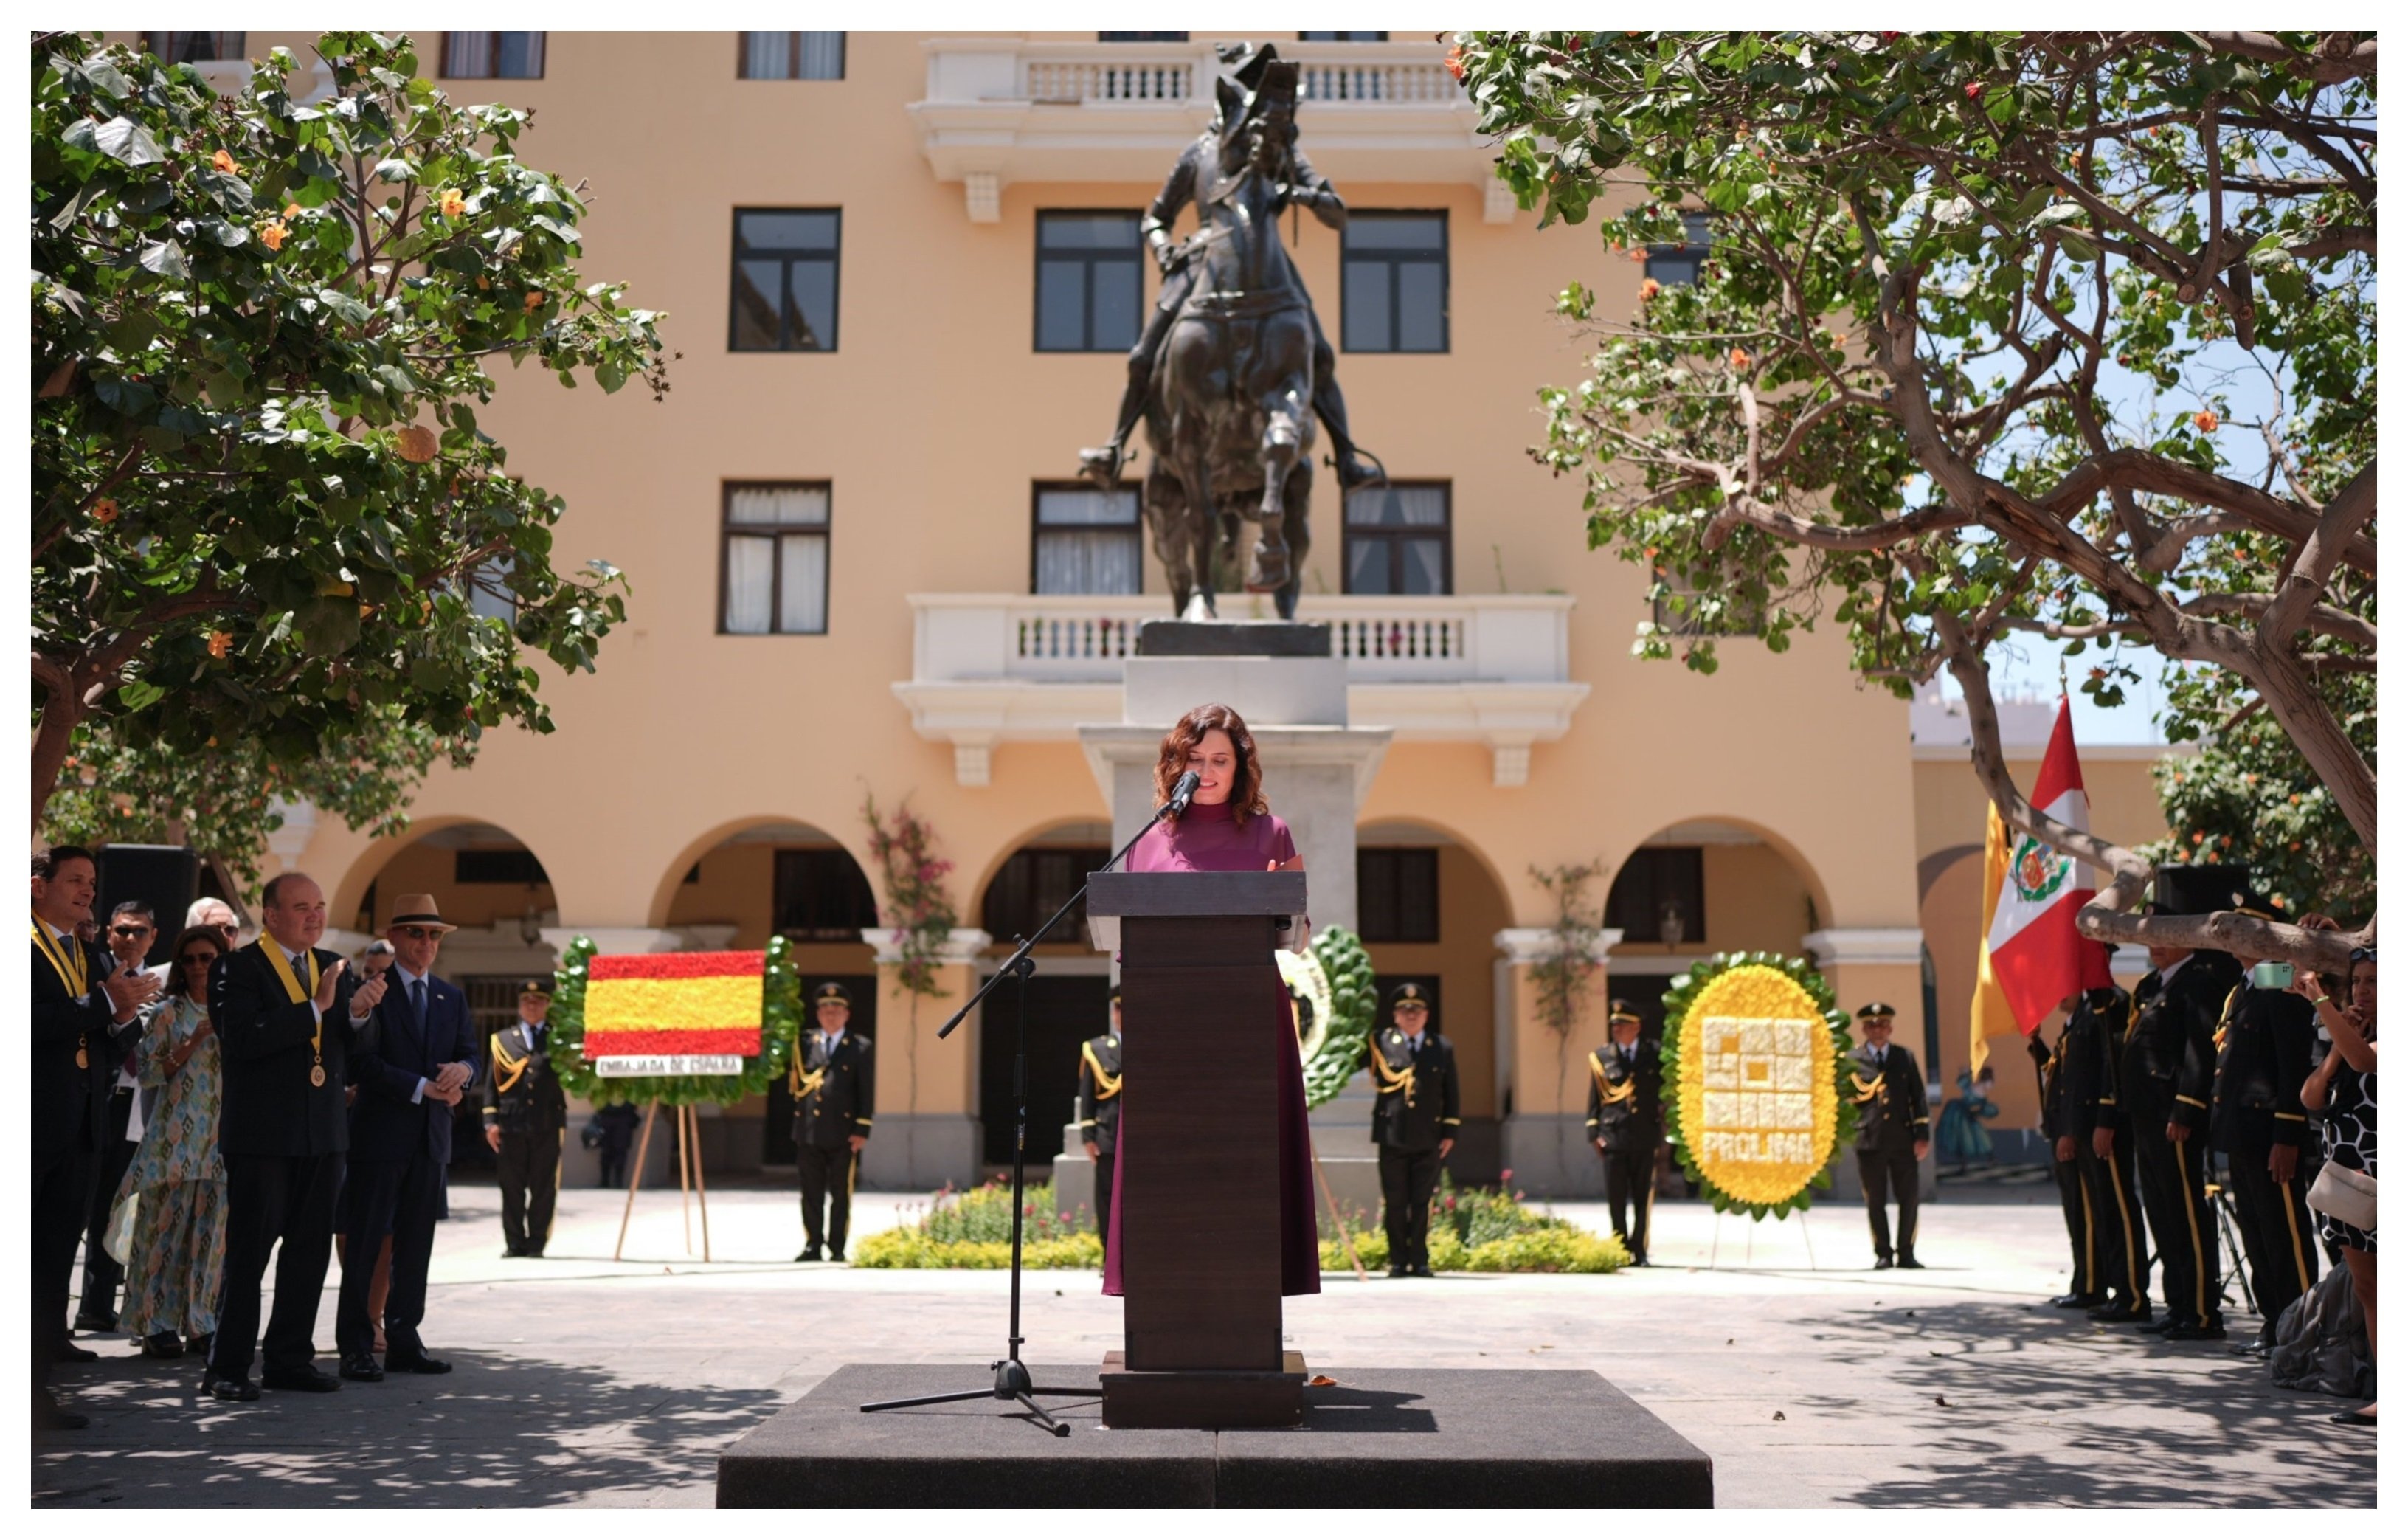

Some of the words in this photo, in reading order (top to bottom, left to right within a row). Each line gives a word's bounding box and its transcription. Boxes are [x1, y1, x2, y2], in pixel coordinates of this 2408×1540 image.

[600, 1060, 665, 1074] EMBAJADA
[670, 1057, 685, 1072] DE
[1703, 1131, 1813, 1164] PROLIMA
